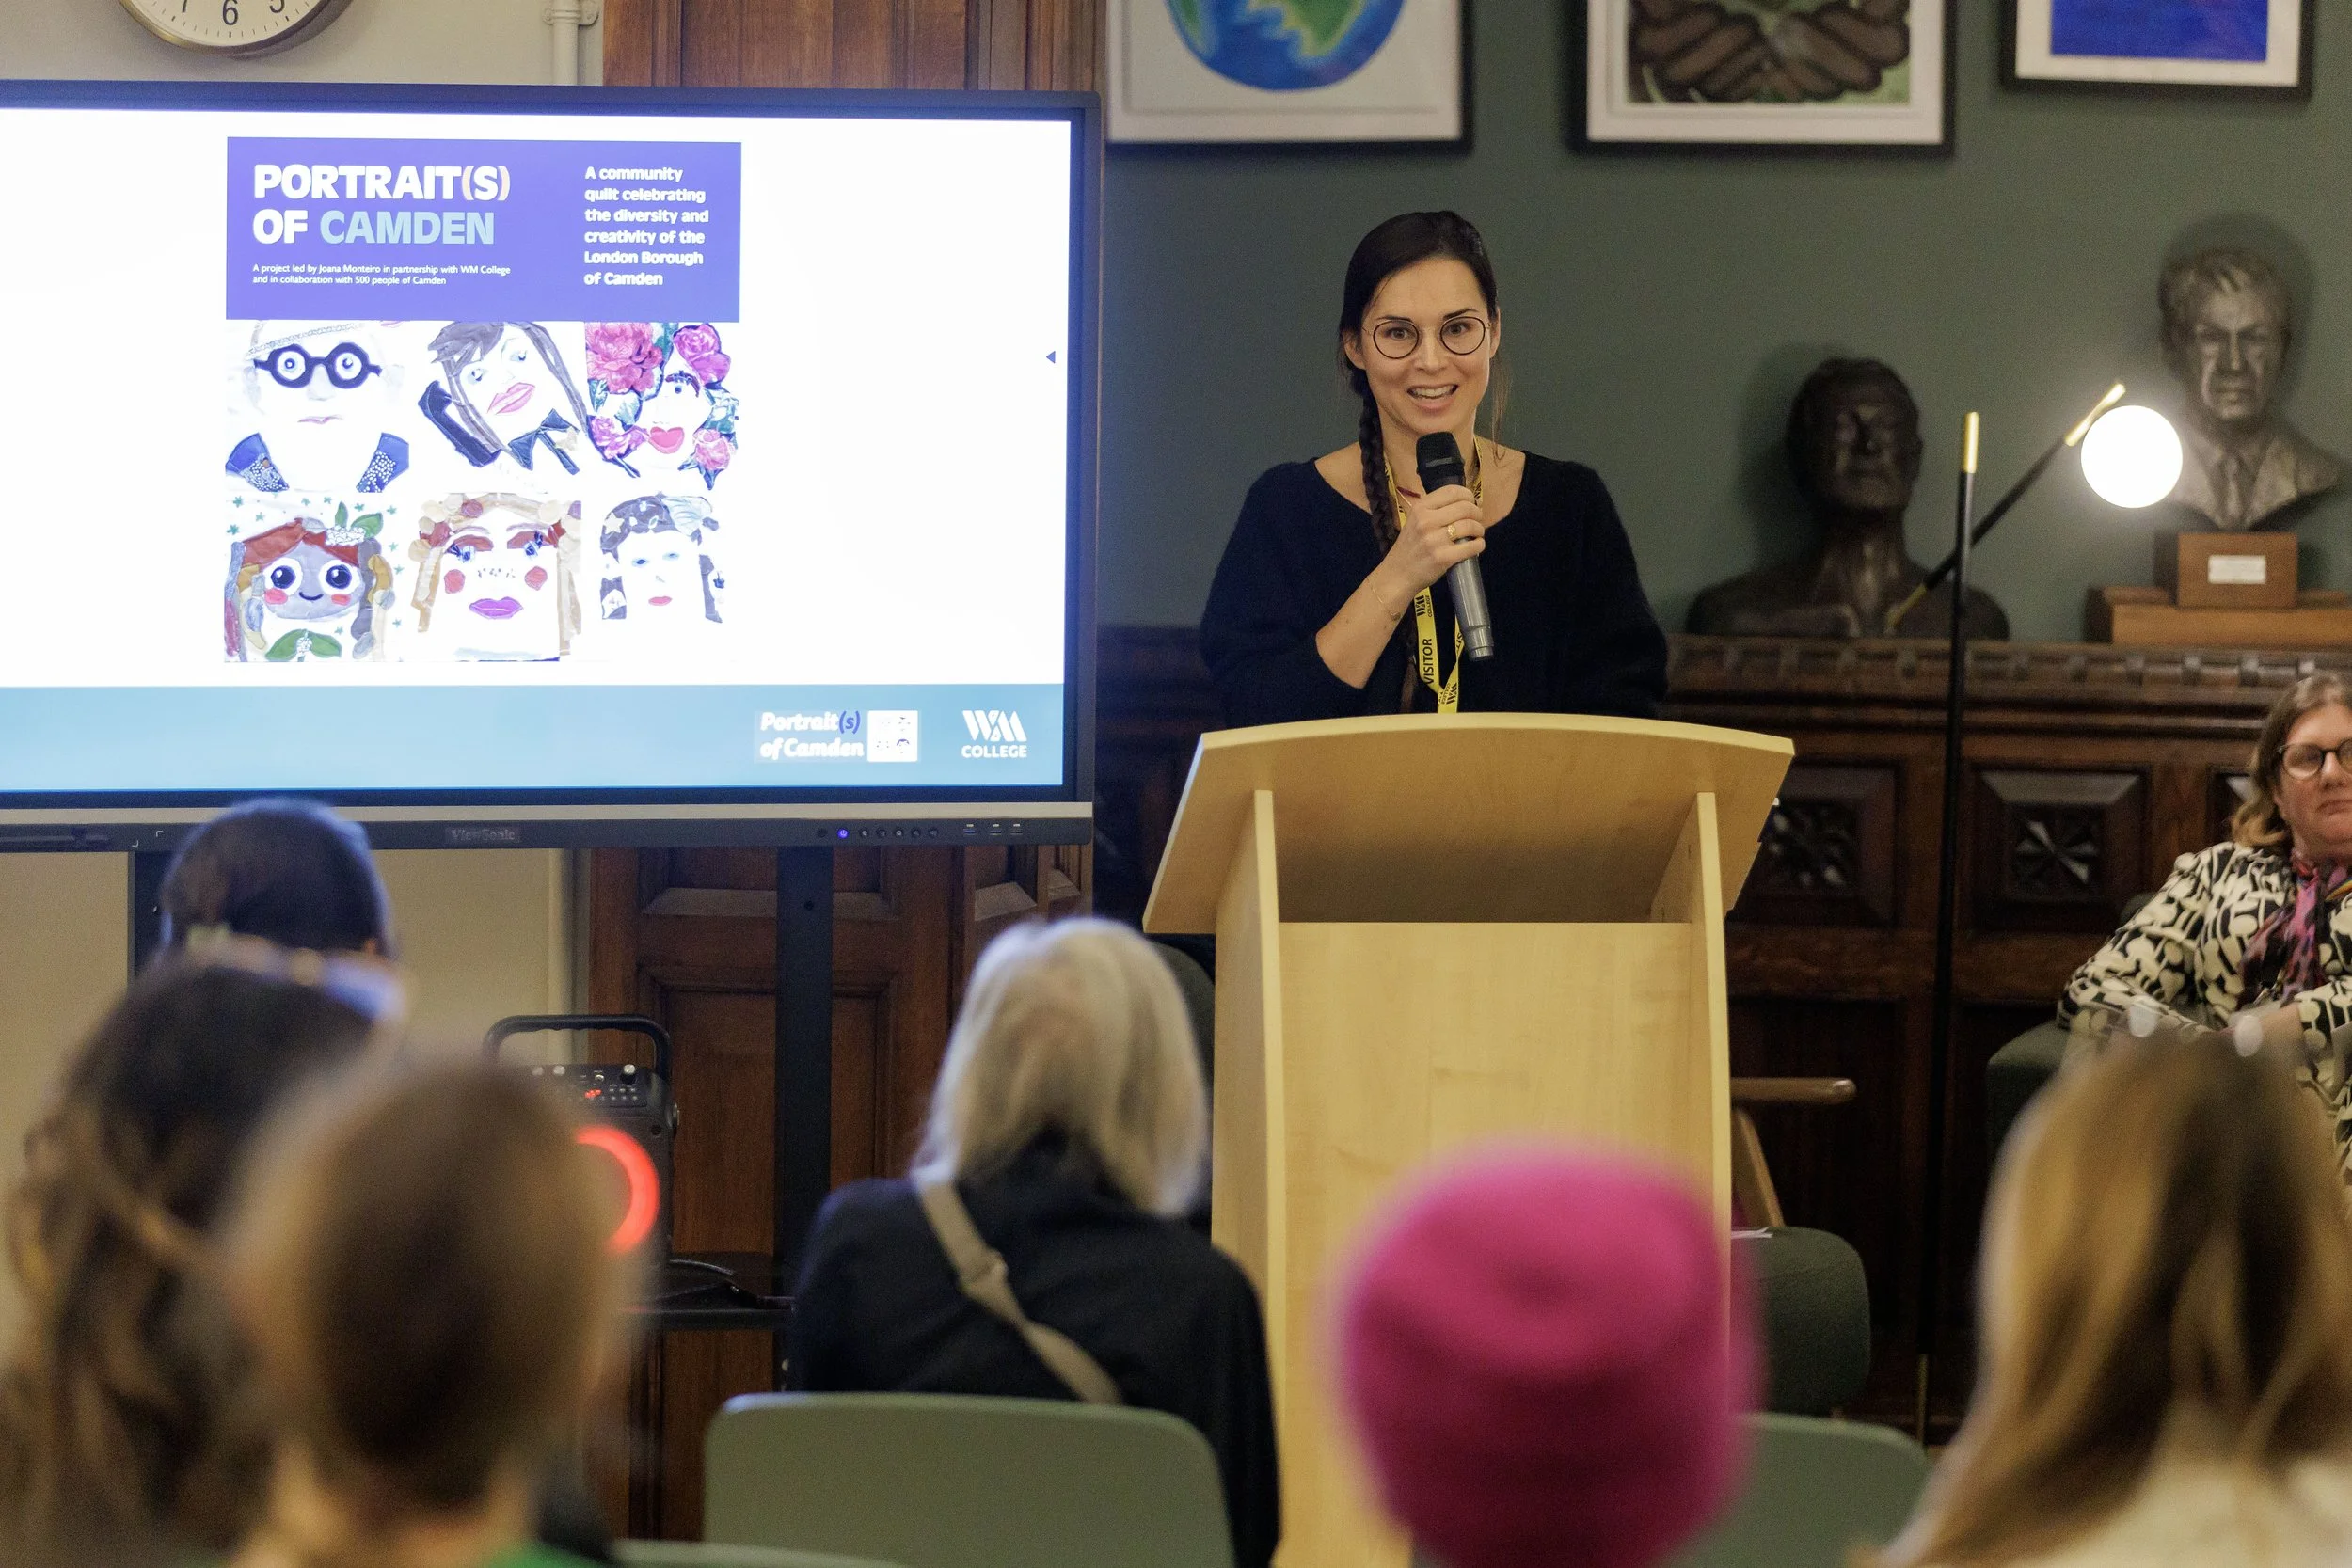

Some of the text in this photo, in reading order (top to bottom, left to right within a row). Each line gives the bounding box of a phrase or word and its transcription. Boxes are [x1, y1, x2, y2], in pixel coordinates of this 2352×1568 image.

[222, 0, 238, 25] 6
[585, 166, 683, 182] A community
[254, 164, 511, 201] PORTRAIT(S)
[584, 188, 706, 204] quilt celebrating
[584, 209, 709, 224] the diversity and
[253, 209, 494, 245] OF CAMDEN
[584, 230, 706, 245] creativity of the
[584, 251, 704, 266] London Borough
[253, 263, 260, 272] A
[262, 264, 290, 275] project
[292, 264, 306, 273] led
[308, 264, 317, 275] by
[319, 264, 342, 274] Joana
[343, 264, 381, 273] Monteiro
[392, 265, 438, 275] partnership
[440, 265, 458, 274] with
[461, 265, 478, 274] WM
[480, 265, 511, 276] College
[279, 276, 333, 284] collaboration
[335, 276, 353, 284] with
[355, 276, 370, 284] 500
[372, 277, 400, 286] people
[583, 272, 663, 285] of Camden
[1422, 638, 1435, 685] VISITOR
[760, 710, 861, 734] Portrait(s)
[760, 736, 865, 761] of Camden
[961, 745, 1027, 758] COLLEGE
